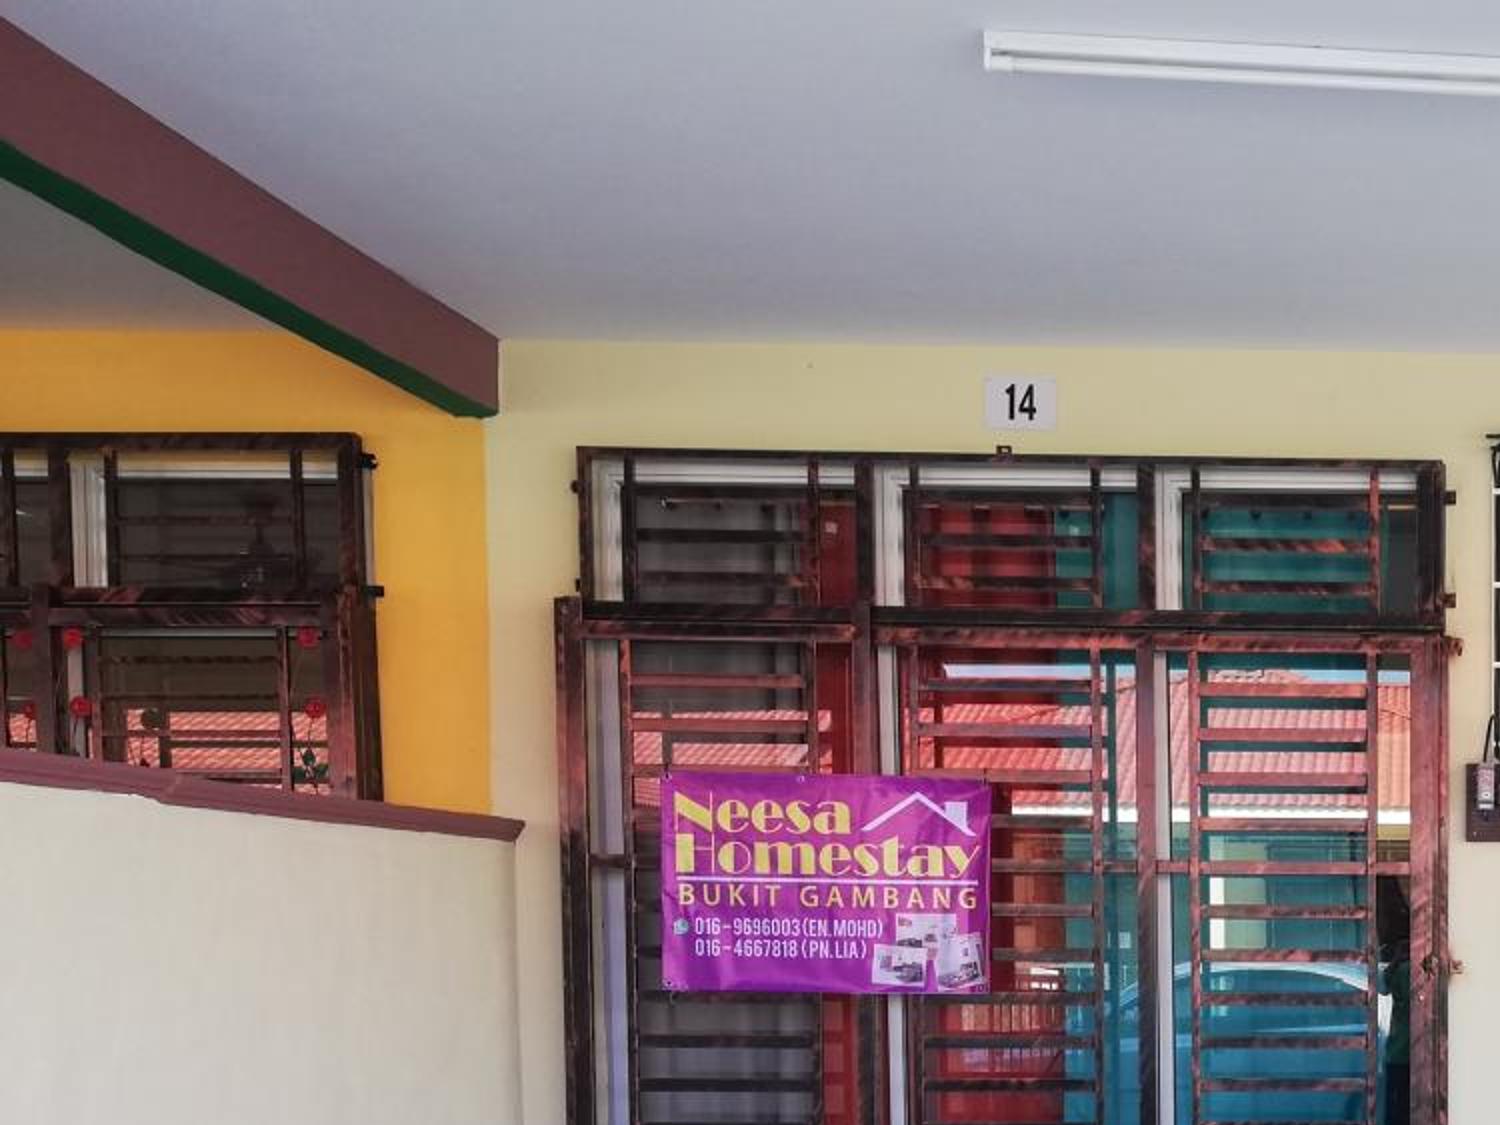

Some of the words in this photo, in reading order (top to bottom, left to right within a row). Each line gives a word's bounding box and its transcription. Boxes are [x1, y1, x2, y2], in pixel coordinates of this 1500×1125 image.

[1005, 383, 1037, 421] 14
[673, 791, 851, 834] Neesa
[675, 833, 980, 879] Homestay
[678, 883, 781, 907] BUKIT
[799, 885, 978, 910] GAMBANG
